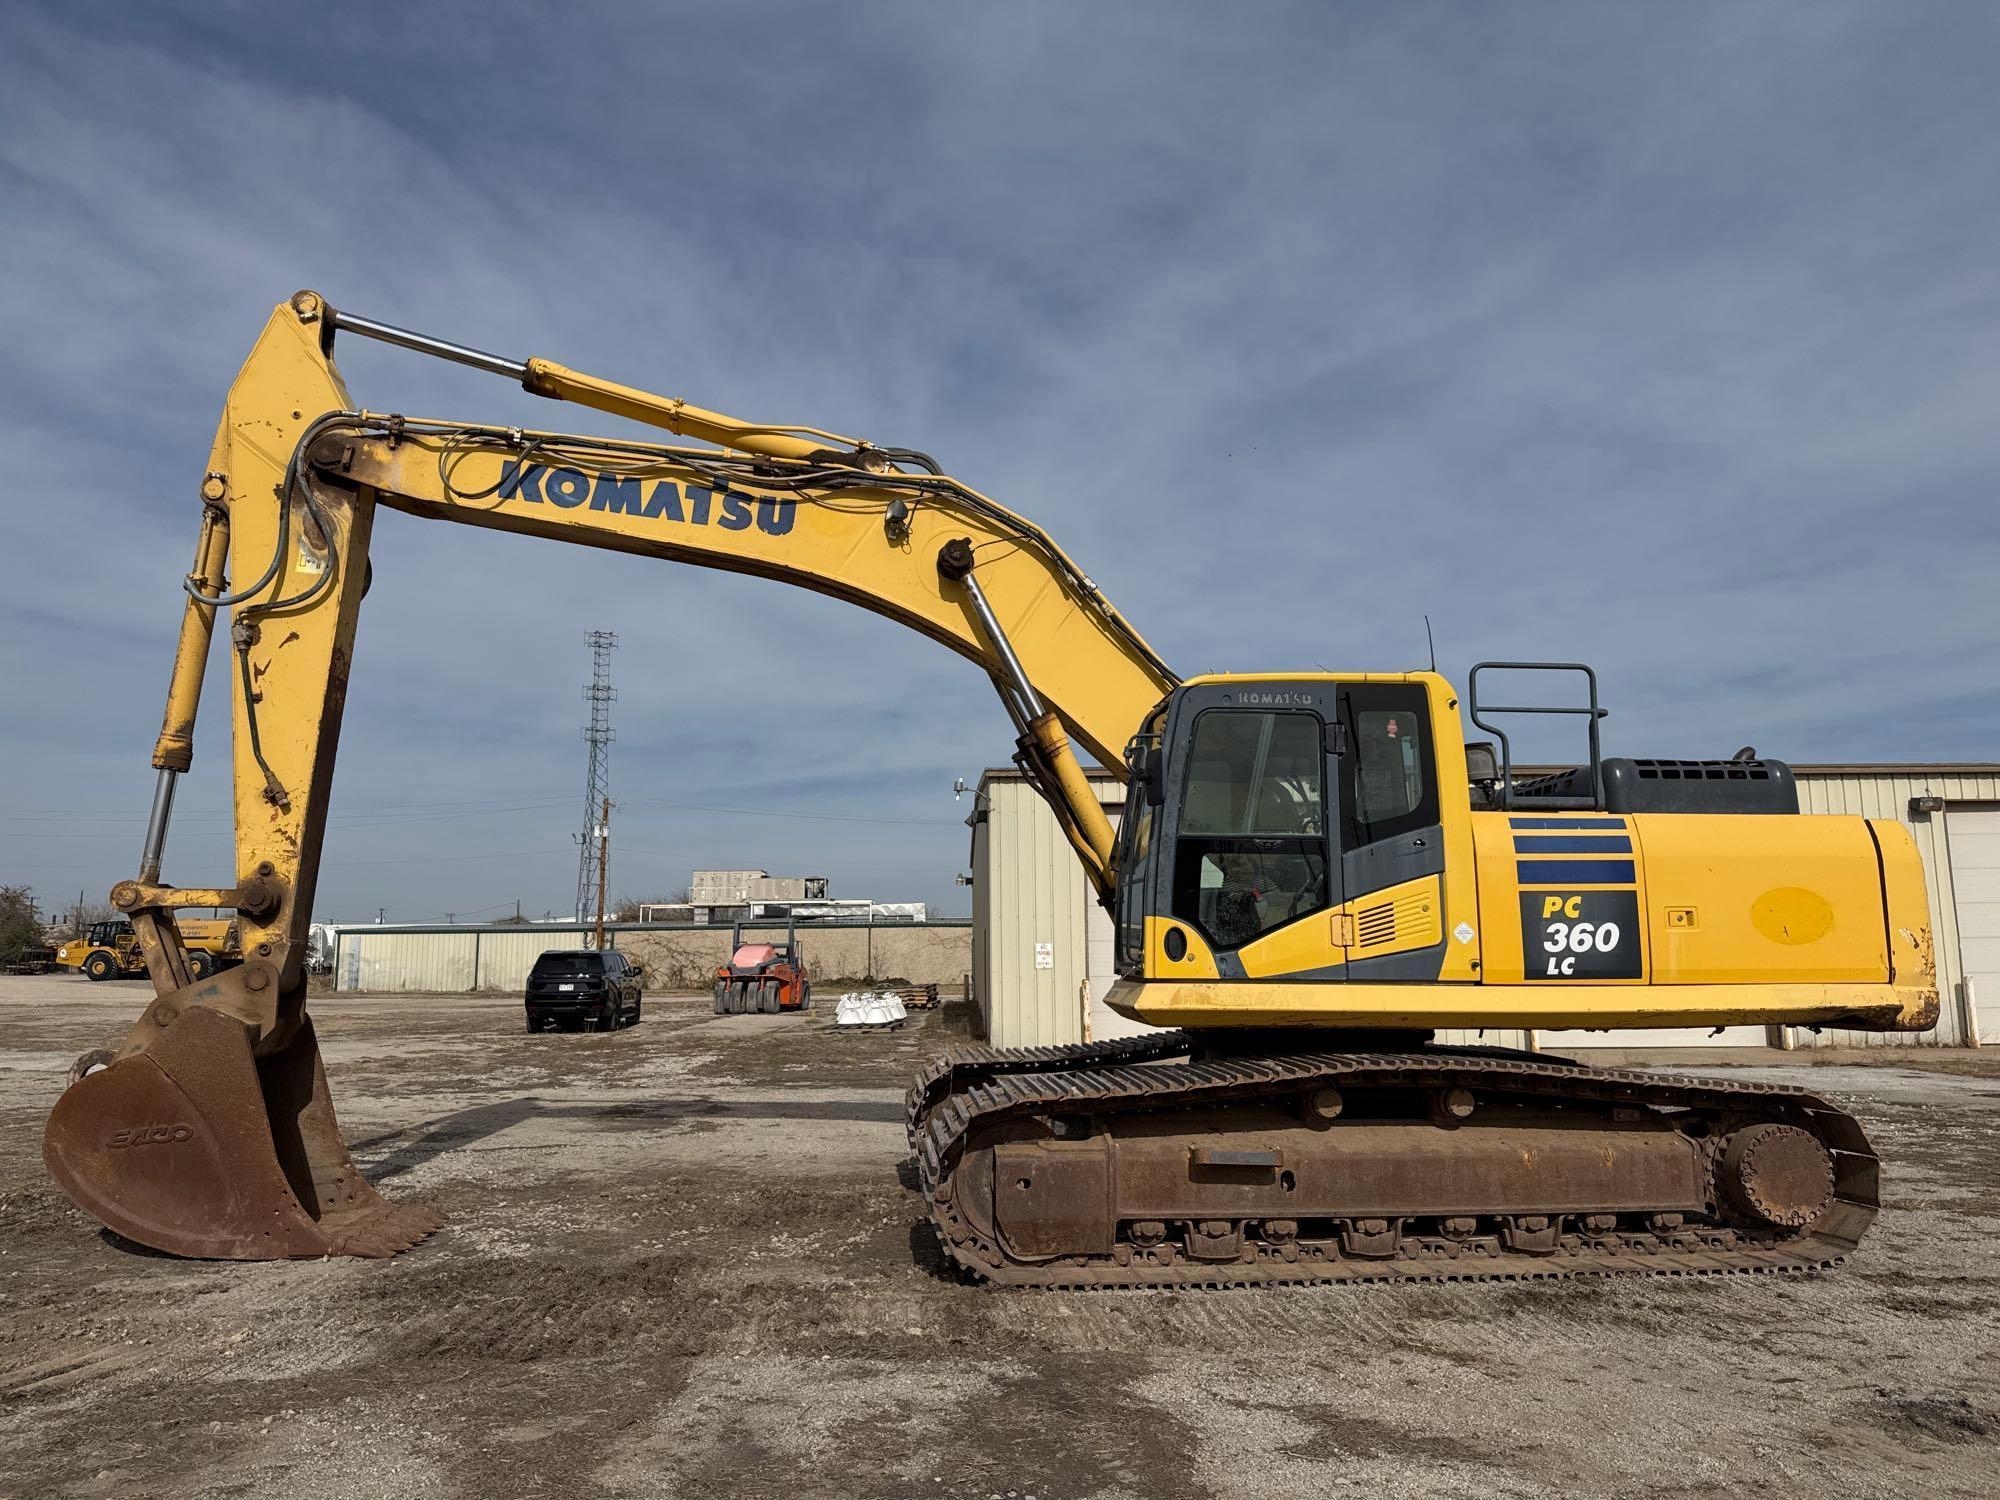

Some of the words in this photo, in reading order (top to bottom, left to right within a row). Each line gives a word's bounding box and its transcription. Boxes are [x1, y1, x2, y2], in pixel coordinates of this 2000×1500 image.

[498, 459, 797, 536] KOMATSU
[1239, 691, 1312, 704] KOMATSU
[1543, 896, 1582, 919] PC
[1543, 922, 1620, 953] 360
[1546, 957, 1576, 975] LC
